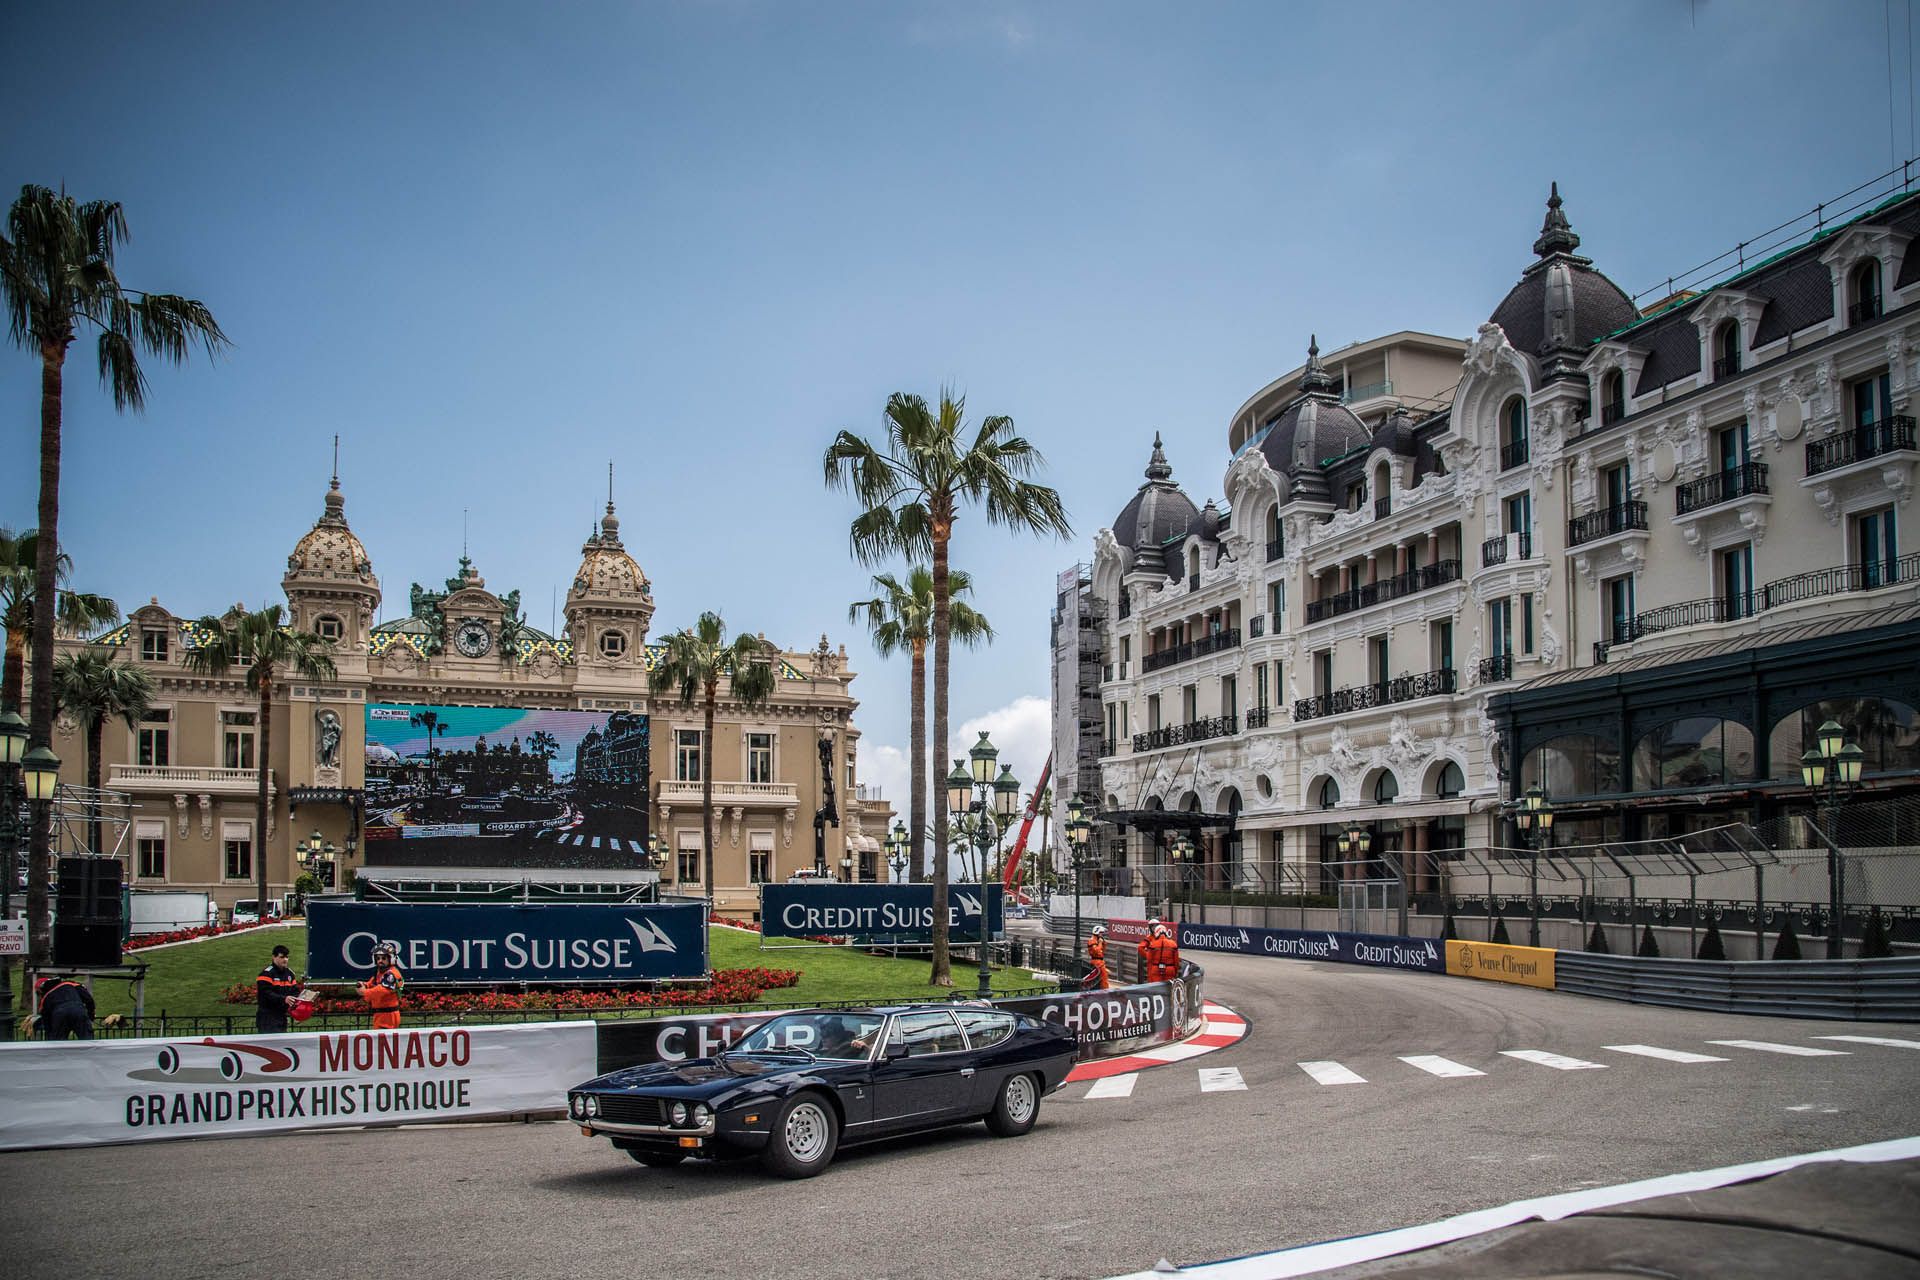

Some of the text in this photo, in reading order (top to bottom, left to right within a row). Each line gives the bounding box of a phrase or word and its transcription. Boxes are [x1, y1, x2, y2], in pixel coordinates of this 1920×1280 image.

[486, 823, 526, 831] CHOPARD
[782, 902, 960, 929] CREDIT SUISE
[342, 931, 633, 970] CREDIT SUISSE
[1183, 930, 1214, 947] CREDIT
[1214, 932, 1241, 950] SUISSE
[1264, 935, 1329, 957] CREDIT SUISSE
[1355, 942, 1427, 967] CREDIT SUISSE
[1477, 951, 1537, 978] Veuve Clicquot
[1077, 1024, 1152, 1043] FICIAL TIMEKEEPER
[319, 1029, 471, 1073] MONACO
[126, 1078, 471, 1127] GRAND PRIX HISTORIQUE
